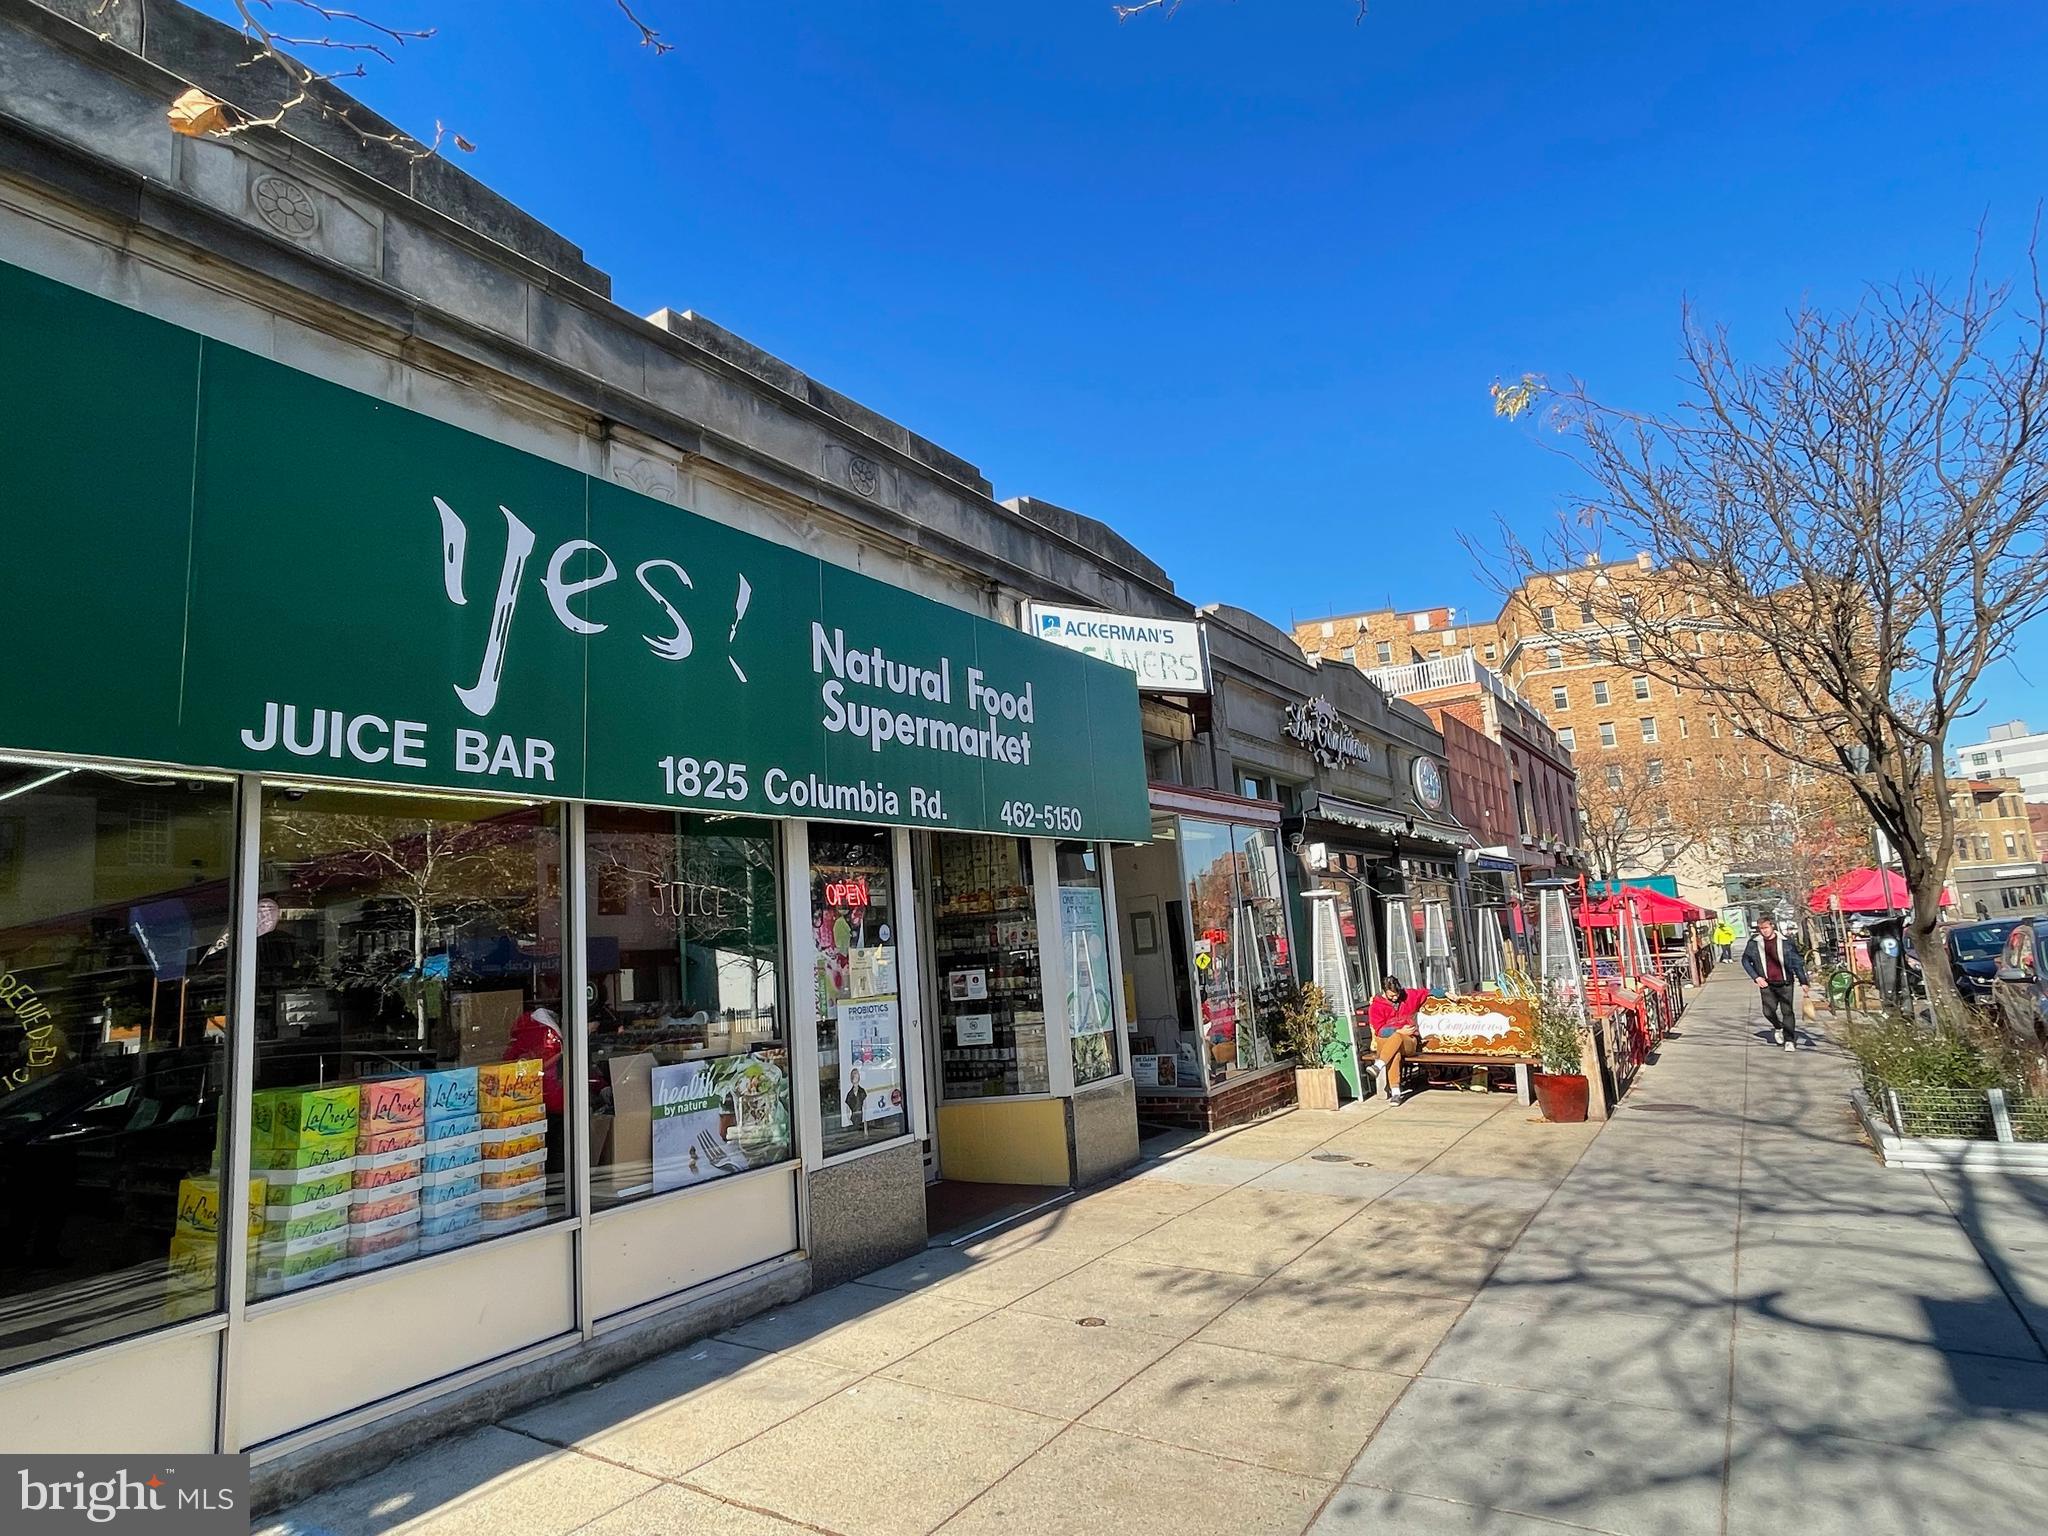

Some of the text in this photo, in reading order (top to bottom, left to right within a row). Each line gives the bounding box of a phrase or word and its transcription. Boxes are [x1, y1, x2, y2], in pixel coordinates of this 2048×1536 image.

[1065, 620, 1175, 643] ACKERMAN'S
[811, 621, 1034, 724] Natural Food
[822, 679, 1031, 765] Supermarket
[240, 701, 556, 782] JUICE BAR
[658, 755, 948, 821] 1825 Columbia Rd.
[1000, 801, 1082, 832] 462-5150
[652, 884, 729, 918] JUICE
[826, 883, 868, 906] OPEN
[848, 1003, 889, 1015] PROBIOTICS
[664, 1100, 708, 1117] by nature
